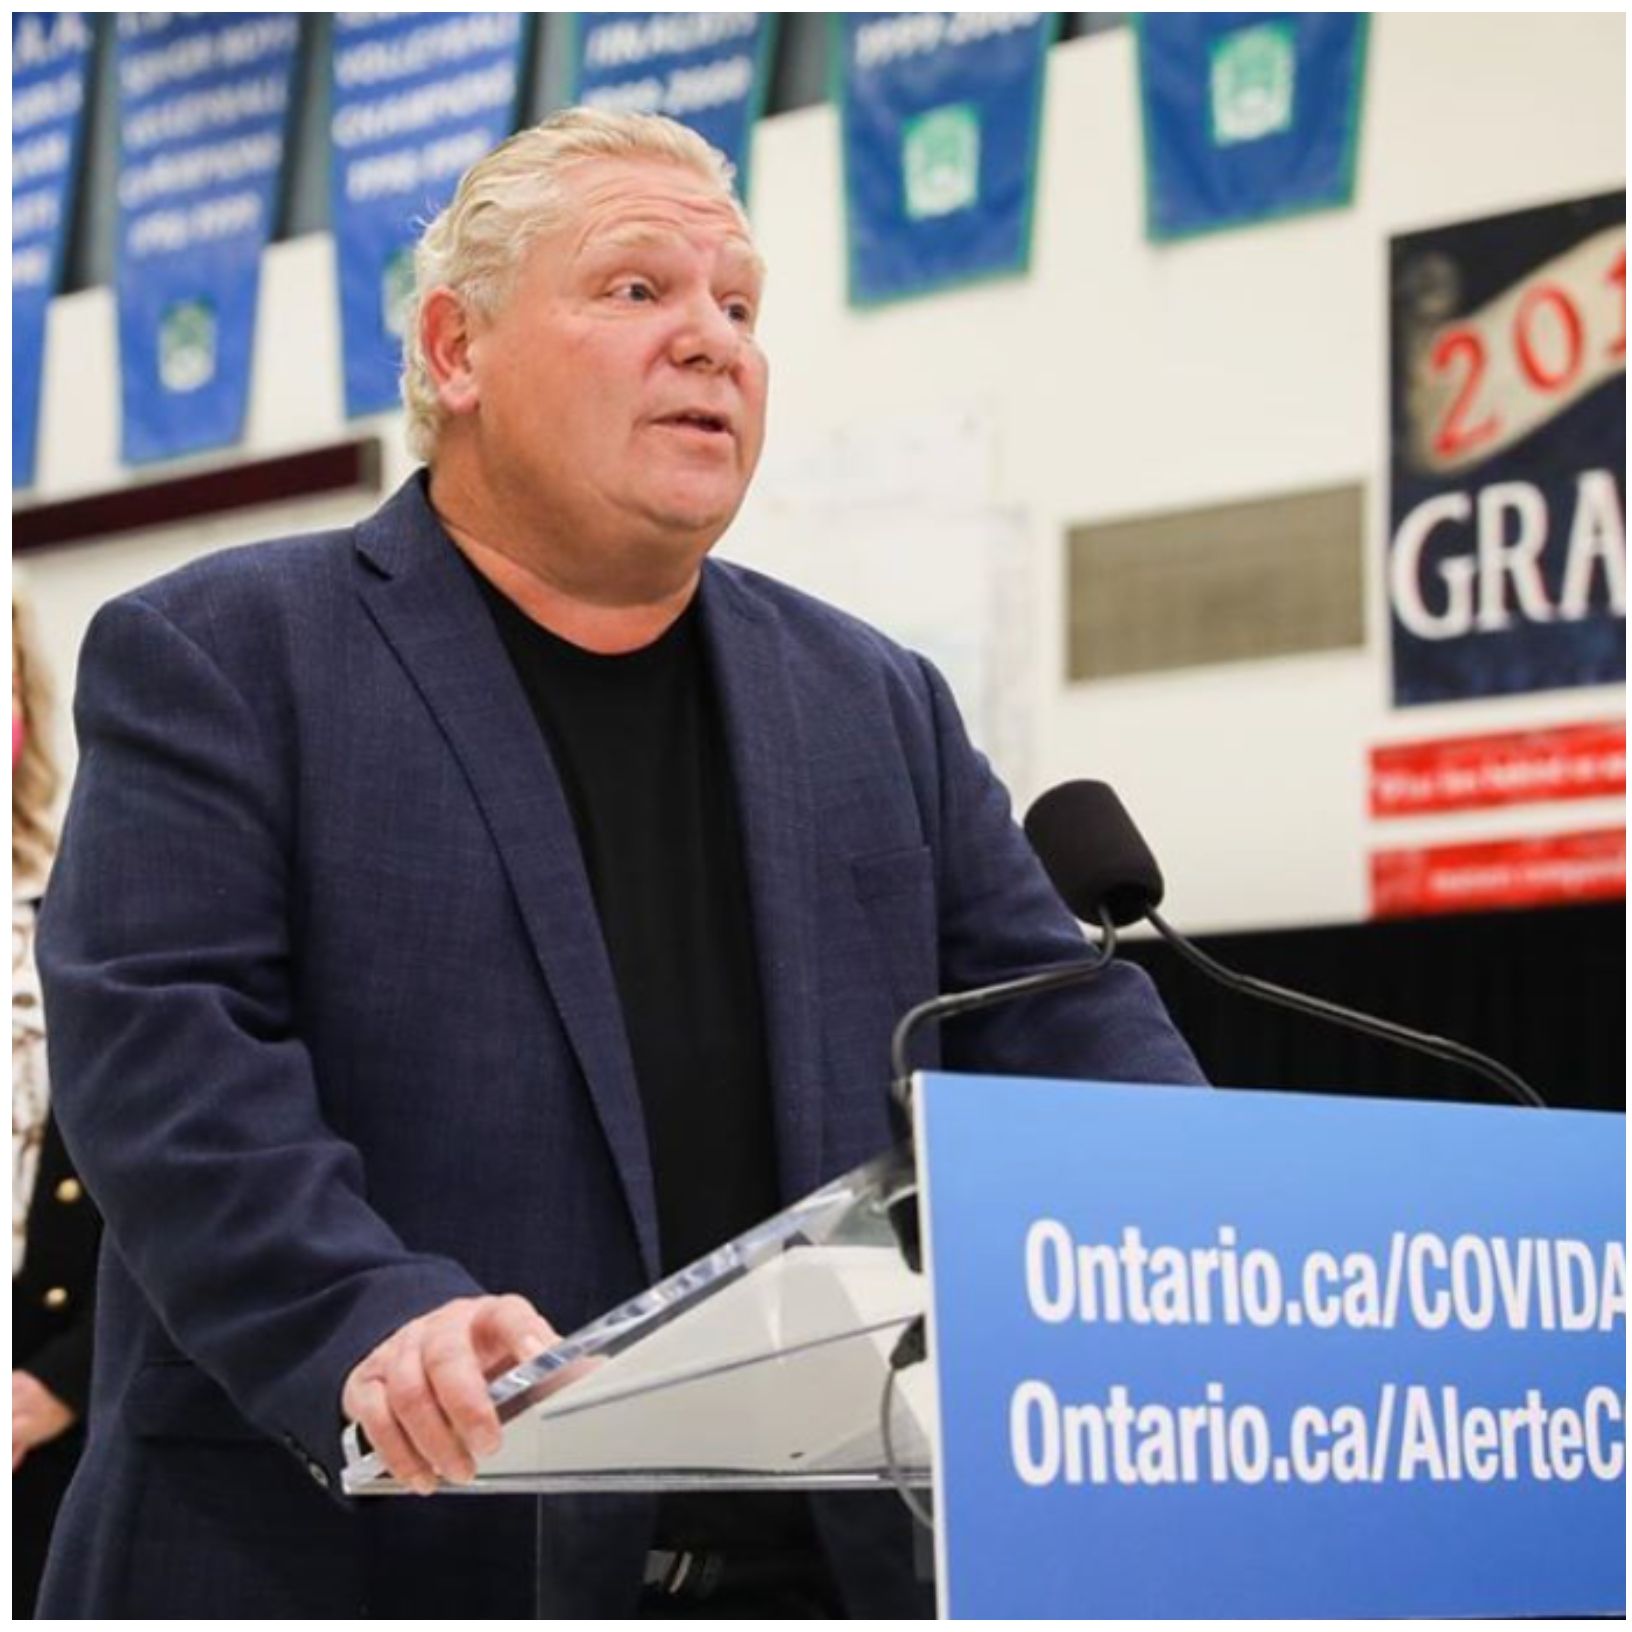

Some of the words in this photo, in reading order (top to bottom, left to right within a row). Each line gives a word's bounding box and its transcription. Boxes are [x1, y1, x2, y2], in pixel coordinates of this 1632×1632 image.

[1390, 468, 1626, 640] GRA
[1025, 1218, 1626, 1331] Ontario.ca/COVIDA
[1009, 1380, 1625, 1486] Ontario.ca/AlerteC
